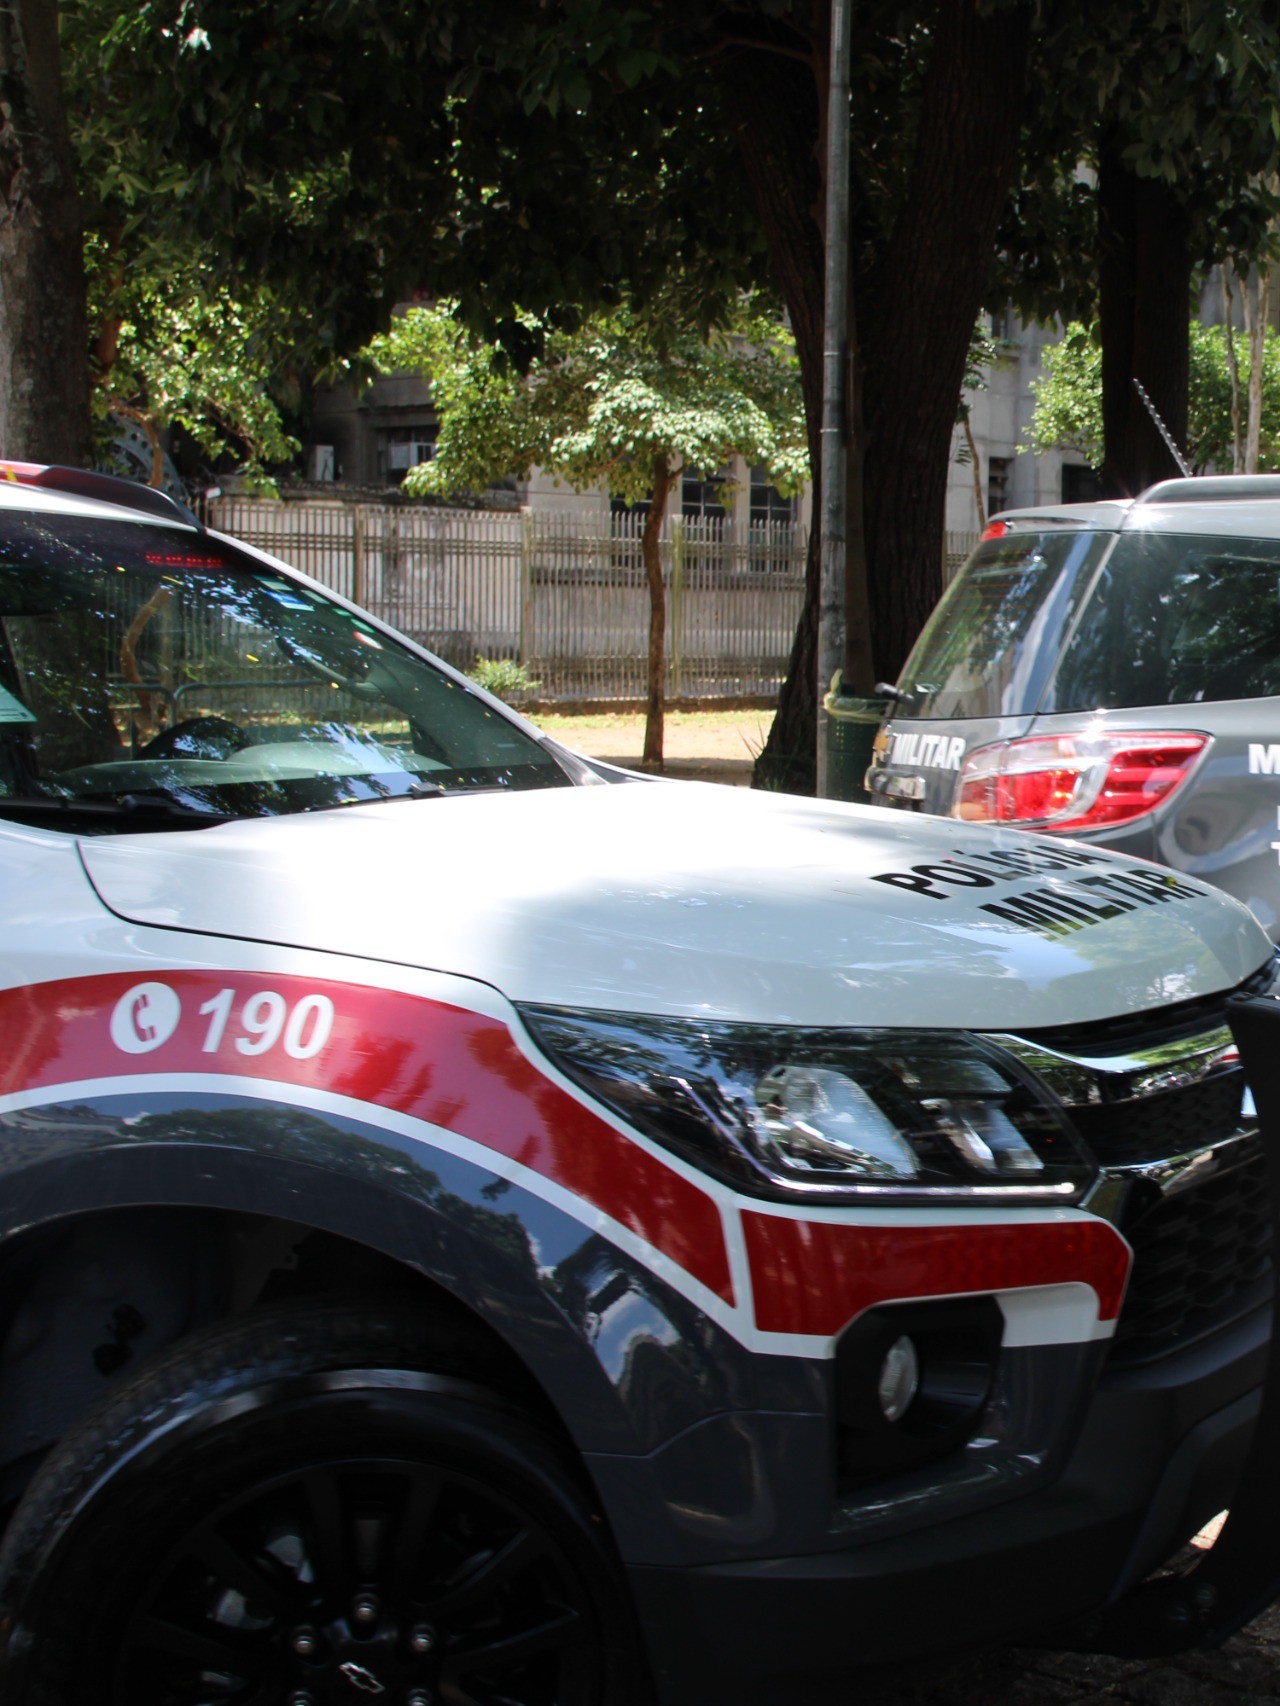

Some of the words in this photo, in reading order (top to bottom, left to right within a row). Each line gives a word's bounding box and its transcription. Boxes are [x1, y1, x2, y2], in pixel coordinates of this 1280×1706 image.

[891, 733, 966, 770] MILITAR
[870, 845, 1112, 900] POLÍCIA
[978, 869, 1209, 941] MILITAR
[198, 988, 335, 1060] 190
